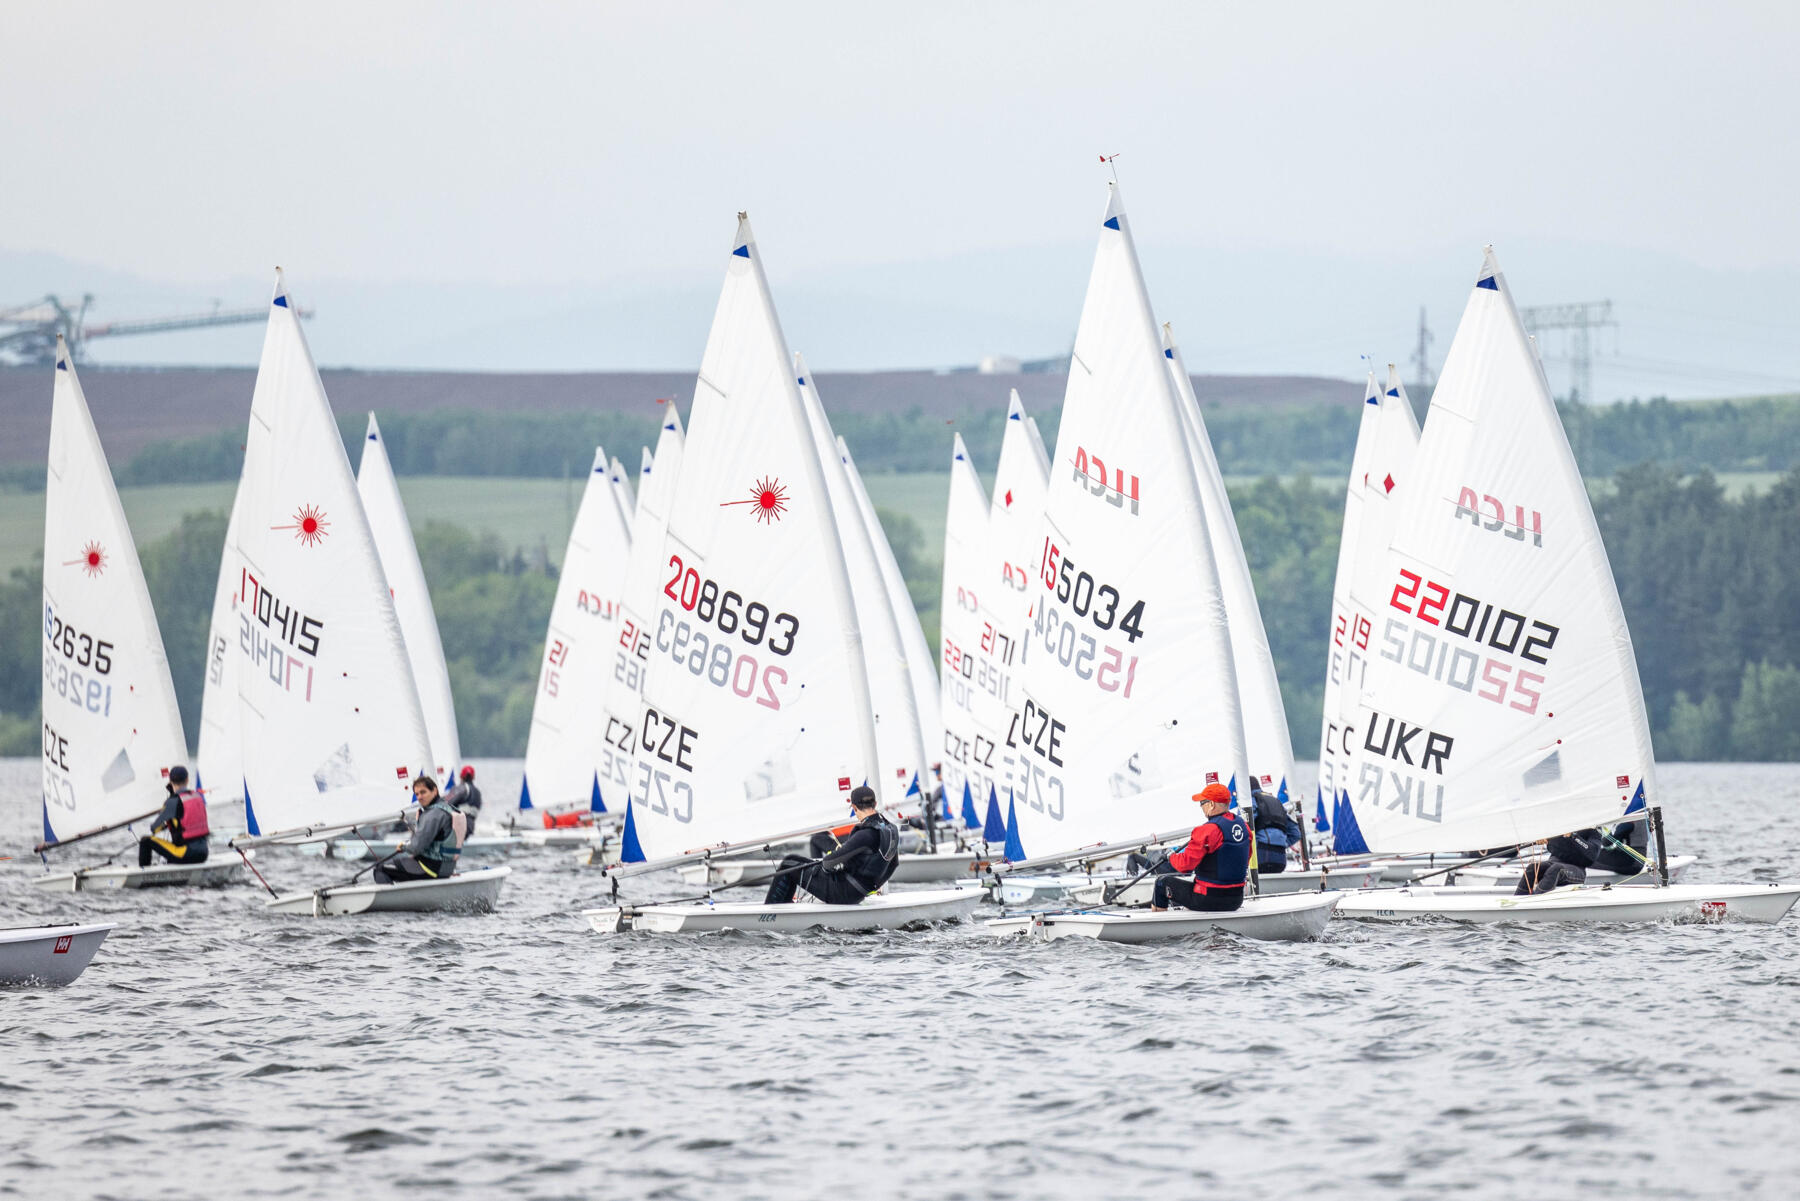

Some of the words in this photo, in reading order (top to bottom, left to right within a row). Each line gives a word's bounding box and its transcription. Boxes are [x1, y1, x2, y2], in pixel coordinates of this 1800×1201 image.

[241, 567, 324, 658] 170415
[664, 554, 800, 656] 208693
[1040, 535, 1146, 644] 155034
[1389, 567, 1560, 666] 220102
[45, 599, 114, 675] 192635
[45, 723, 70, 772] CZE
[605, 716, 637, 755] CZ
[642, 708, 698, 773] CZE
[1022, 698, 1066, 768] CZE
[1363, 711, 1455, 775] UKR
[758, 913, 777, 922] ILCA
[1376, 909, 1395, 917] ILCA
